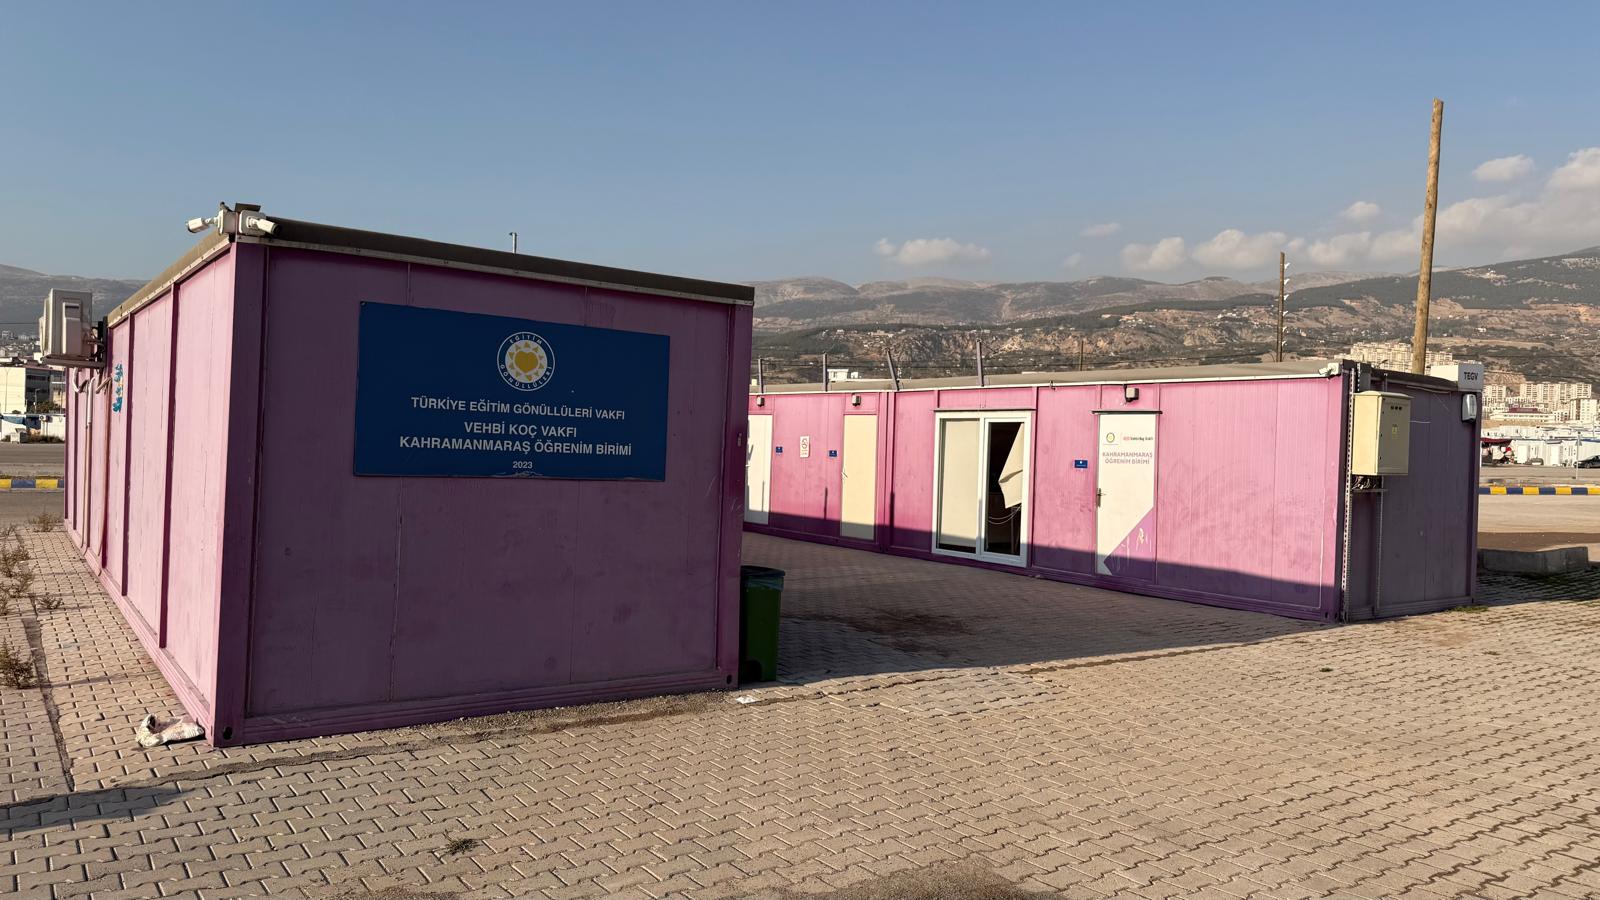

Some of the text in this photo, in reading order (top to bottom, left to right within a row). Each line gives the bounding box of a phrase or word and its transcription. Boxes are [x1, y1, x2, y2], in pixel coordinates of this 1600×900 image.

[1464, 372, 1478, 380] TEGV
[411, 396, 625, 420] TÜRKİYE EĞİTİM GÖNÜLLÜLERİ VAKFI
[464, 420, 577, 438] VEHBİ KOÇ VAKFI
[399, 435, 632, 456] KAHRAMANMARAŞ ÖĞRENİM BİRİMİ
[512, 460, 533, 469] 2023
